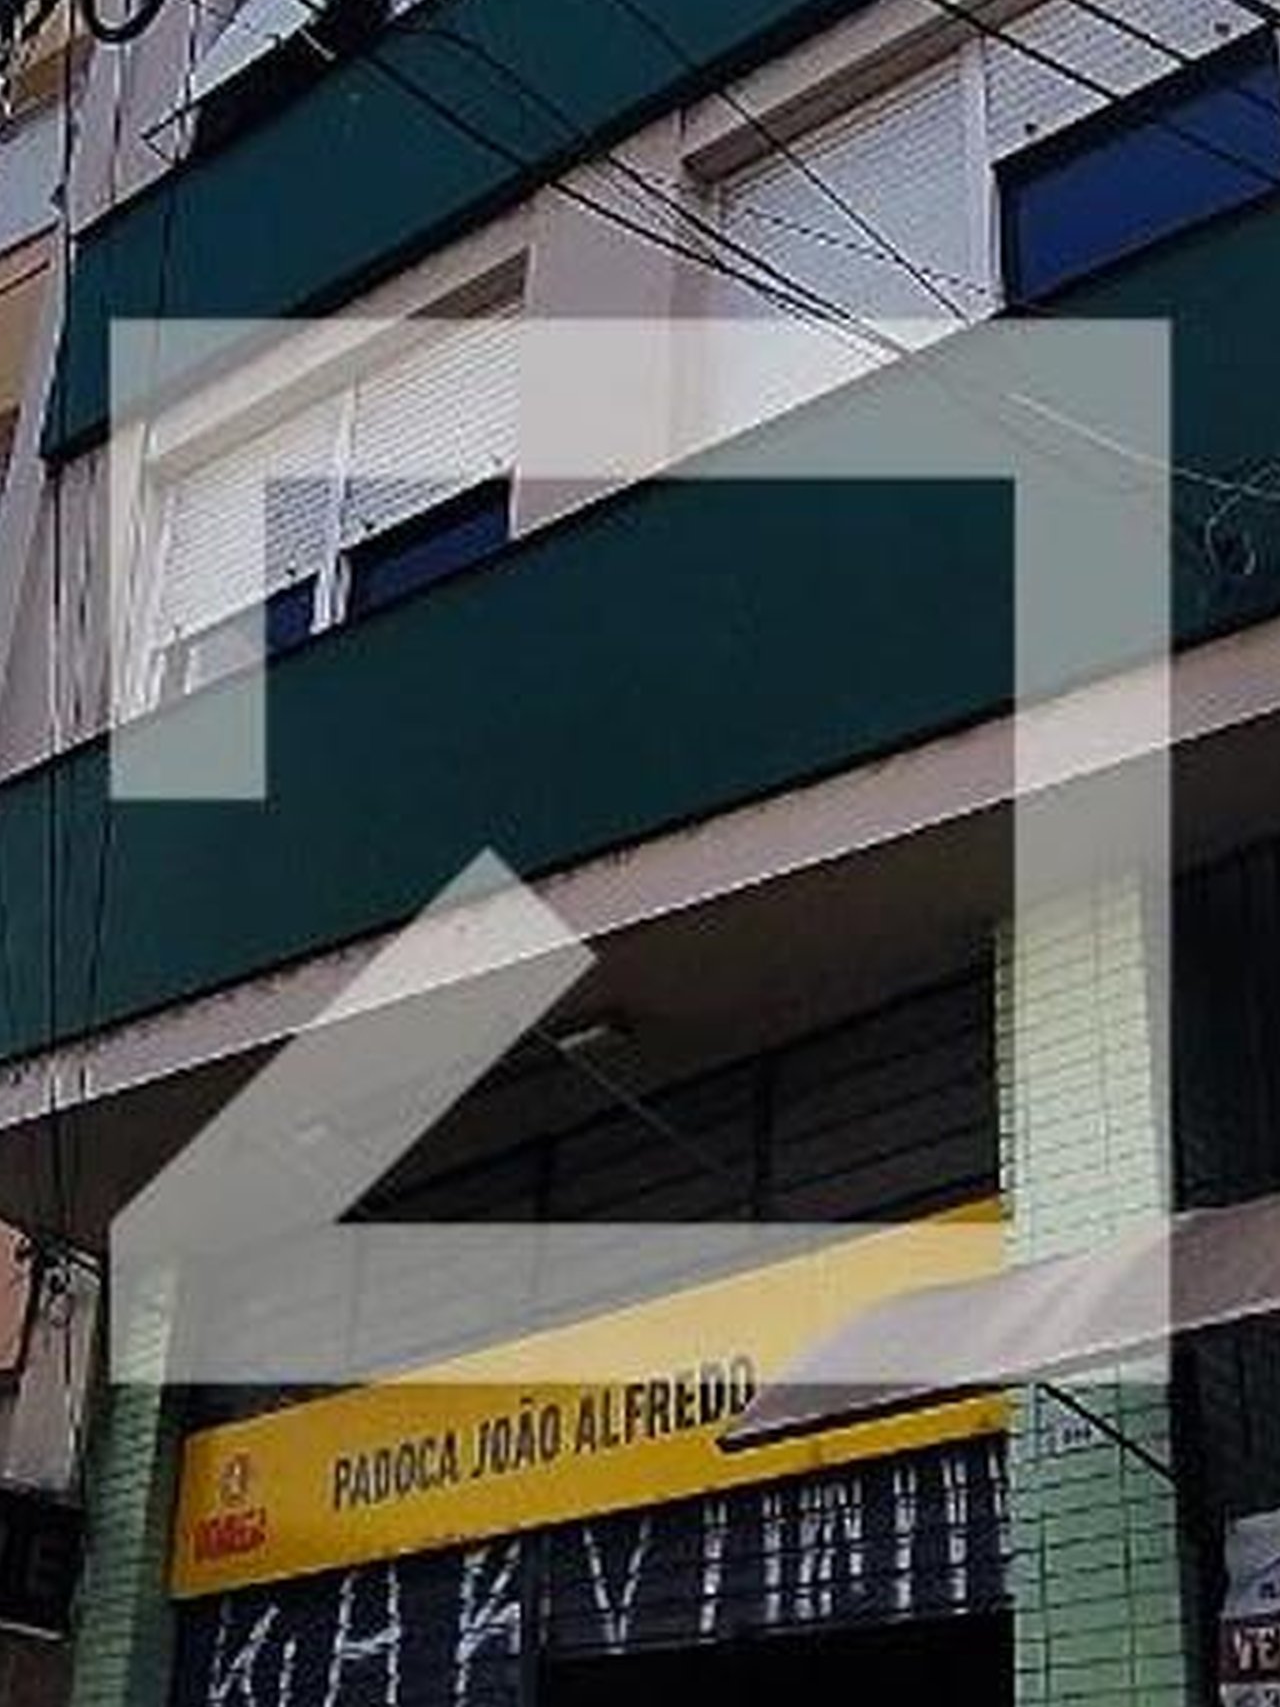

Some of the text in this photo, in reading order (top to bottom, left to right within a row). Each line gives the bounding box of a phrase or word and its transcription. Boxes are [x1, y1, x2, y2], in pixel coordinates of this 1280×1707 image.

[332, 1354, 758, 1511] PADOCA JOÃO ALFREDO
